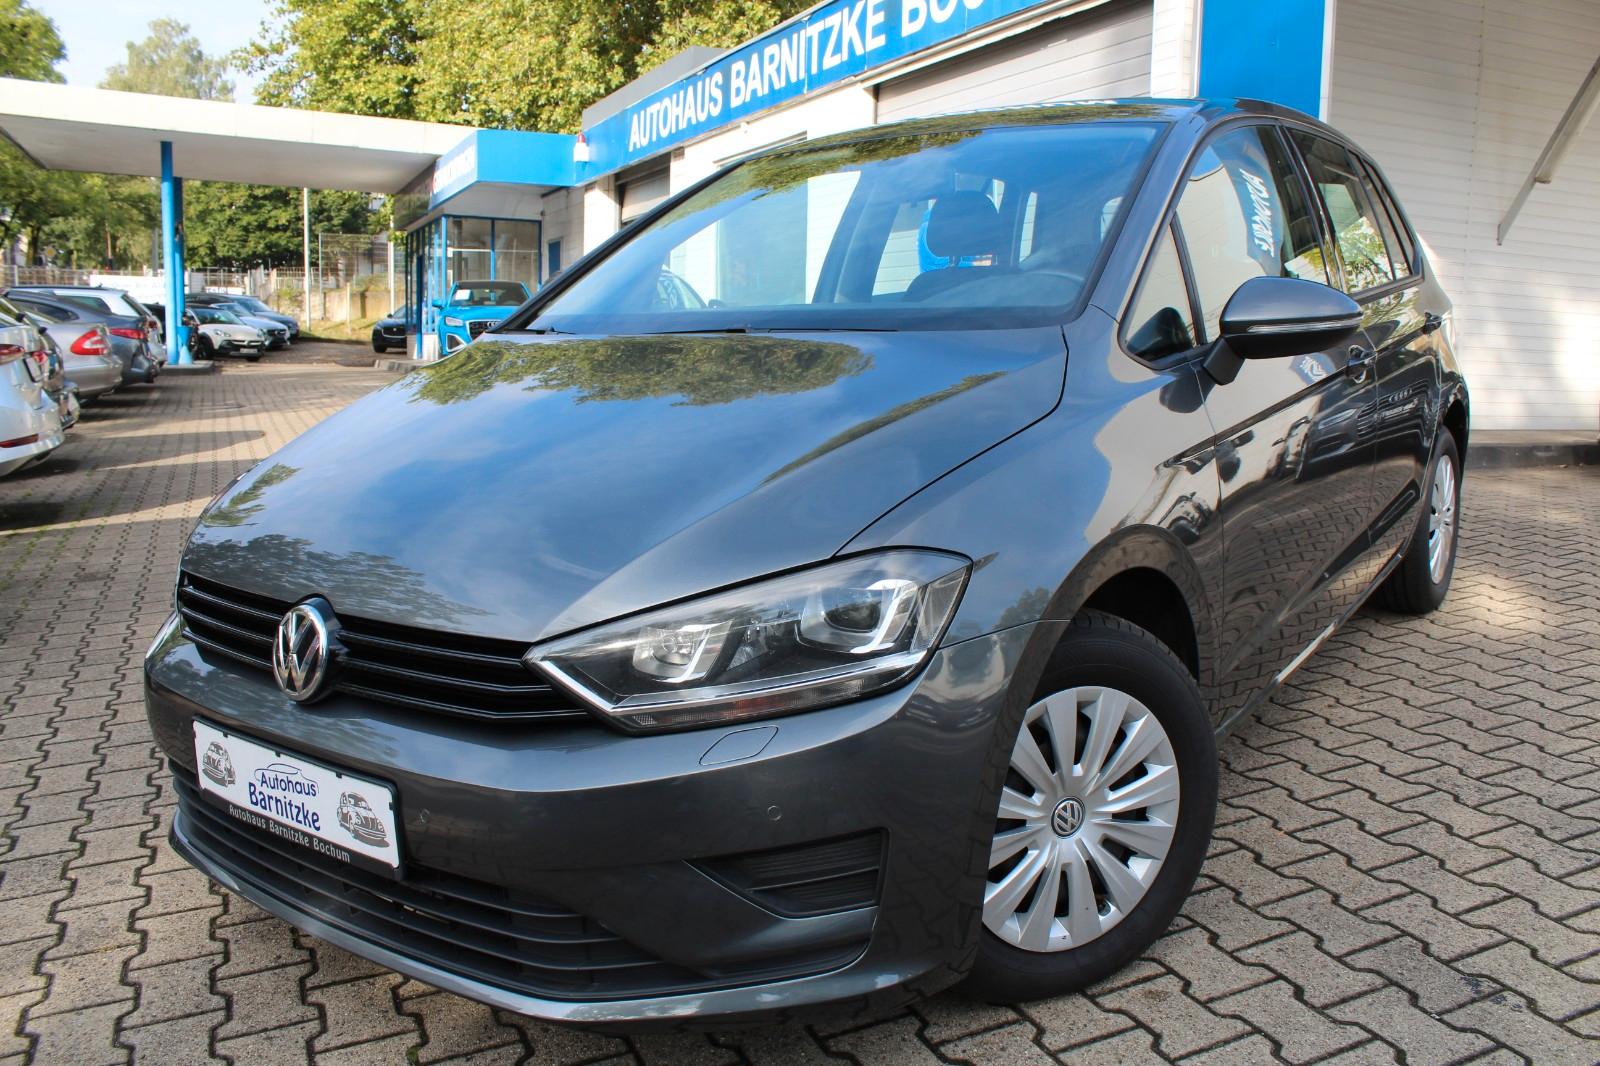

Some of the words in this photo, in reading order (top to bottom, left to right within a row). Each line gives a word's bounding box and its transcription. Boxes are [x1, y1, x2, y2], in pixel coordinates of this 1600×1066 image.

[628, 71, 724, 152] AUTOHAUS
[729, 0, 887, 108] BARNITZKE
[248, 782, 321, 832] Barnitzke
[260, 772, 317, 797] Autohaus
[228, 804, 267, 829] Autohaus
[269, 819, 310, 847] Barnitzke
[313, 839, 351, 863] Bochum
